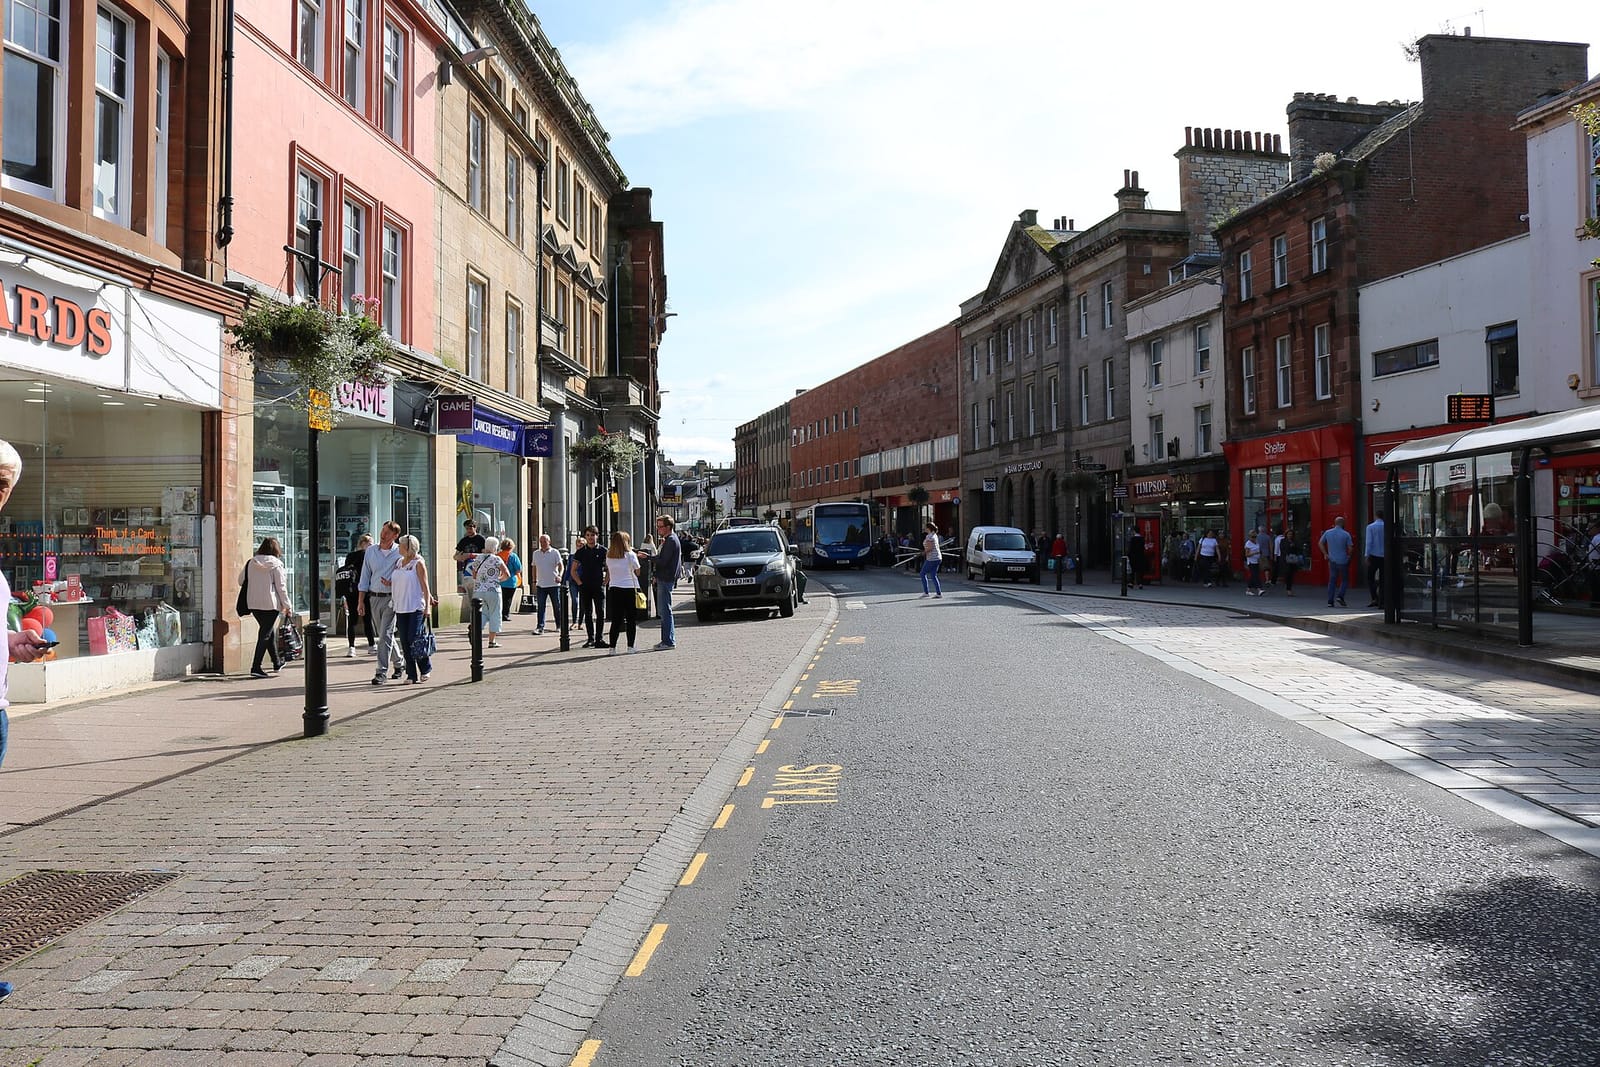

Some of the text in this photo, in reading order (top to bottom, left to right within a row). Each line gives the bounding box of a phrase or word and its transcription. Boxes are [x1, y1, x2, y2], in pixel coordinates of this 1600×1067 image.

[440, 401, 471, 412] GAME
[474, 418, 491, 434] CANCER
[1264, 442, 1287, 455] Shelter
[1135, 479, 1168, 494] TIMPSON
[96, 527, 155, 539] Think of a Card
[103, 543, 124, 555] Think
[127, 544, 135, 555] of
[761, 764, 843, 808] TAXIS
